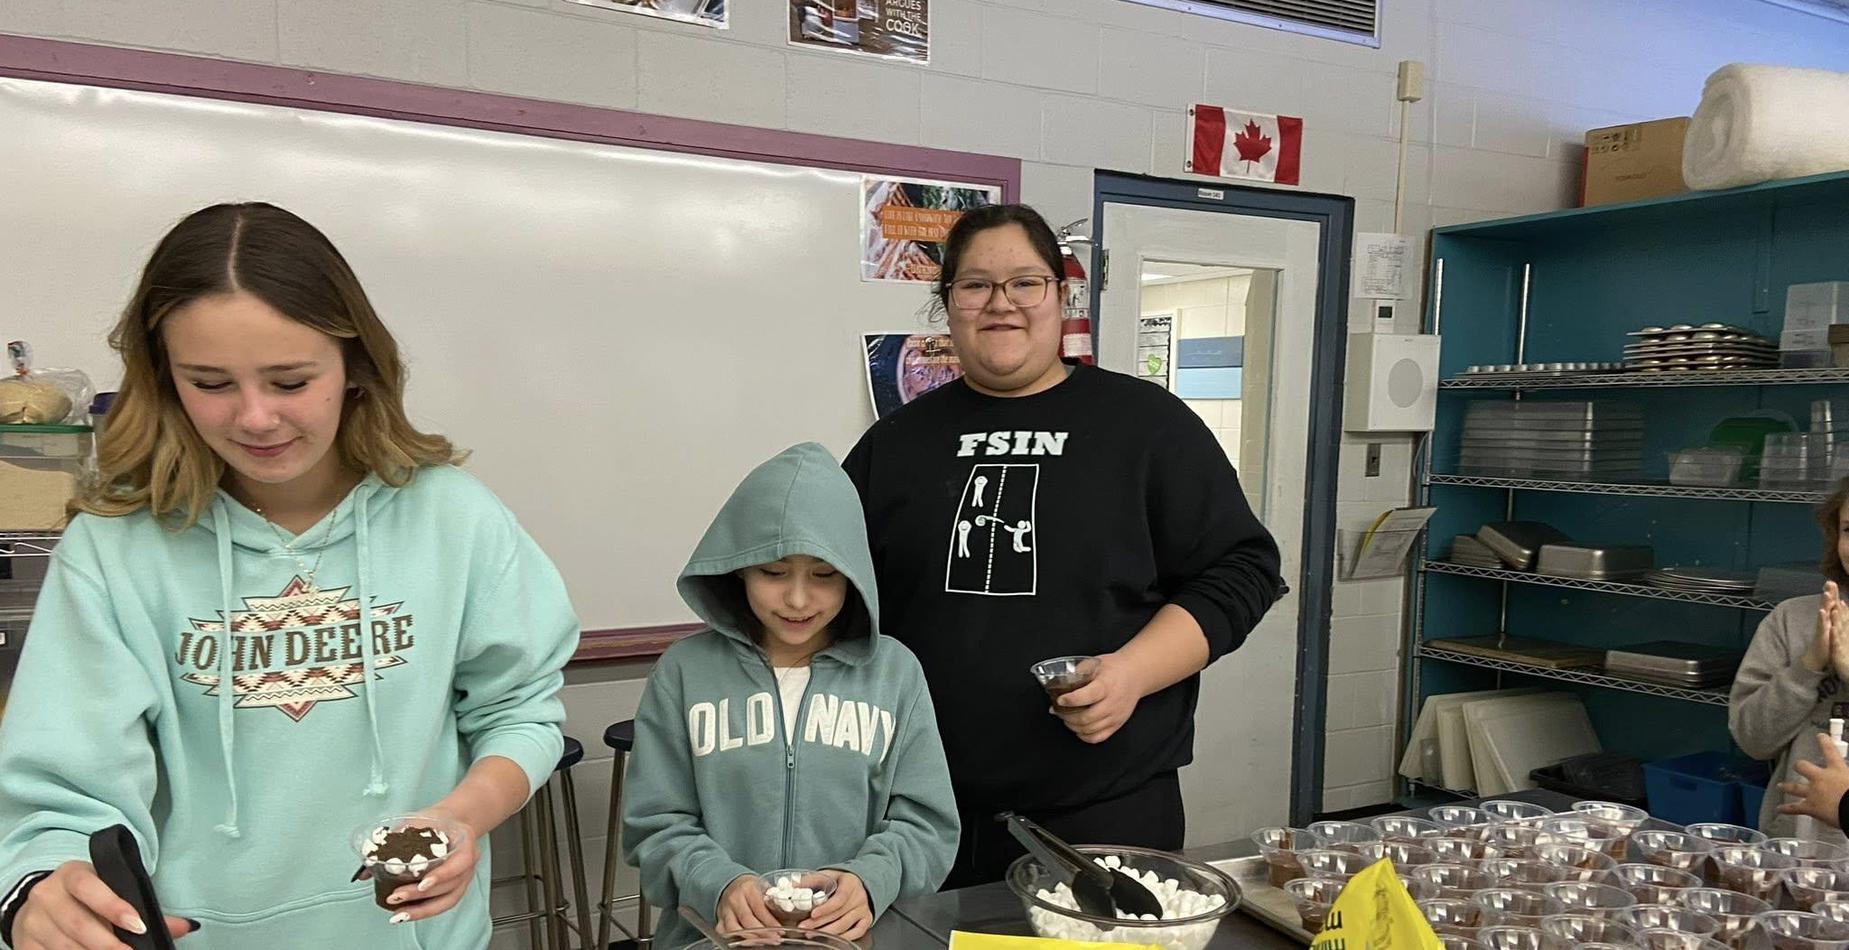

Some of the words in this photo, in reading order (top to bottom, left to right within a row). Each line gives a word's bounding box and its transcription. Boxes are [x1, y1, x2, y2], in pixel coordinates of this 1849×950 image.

[885, 8, 906, 18] WITH
[907, 11, 922, 21] THE
[885, 18, 920, 34] COOK
[957, 431, 1069, 457] FSIN
[174, 632, 274, 671] JOHN
[285, 614, 414, 666] DEERE
[689, 692, 775, 757] OLD
[804, 694, 896, 764] NAVY
